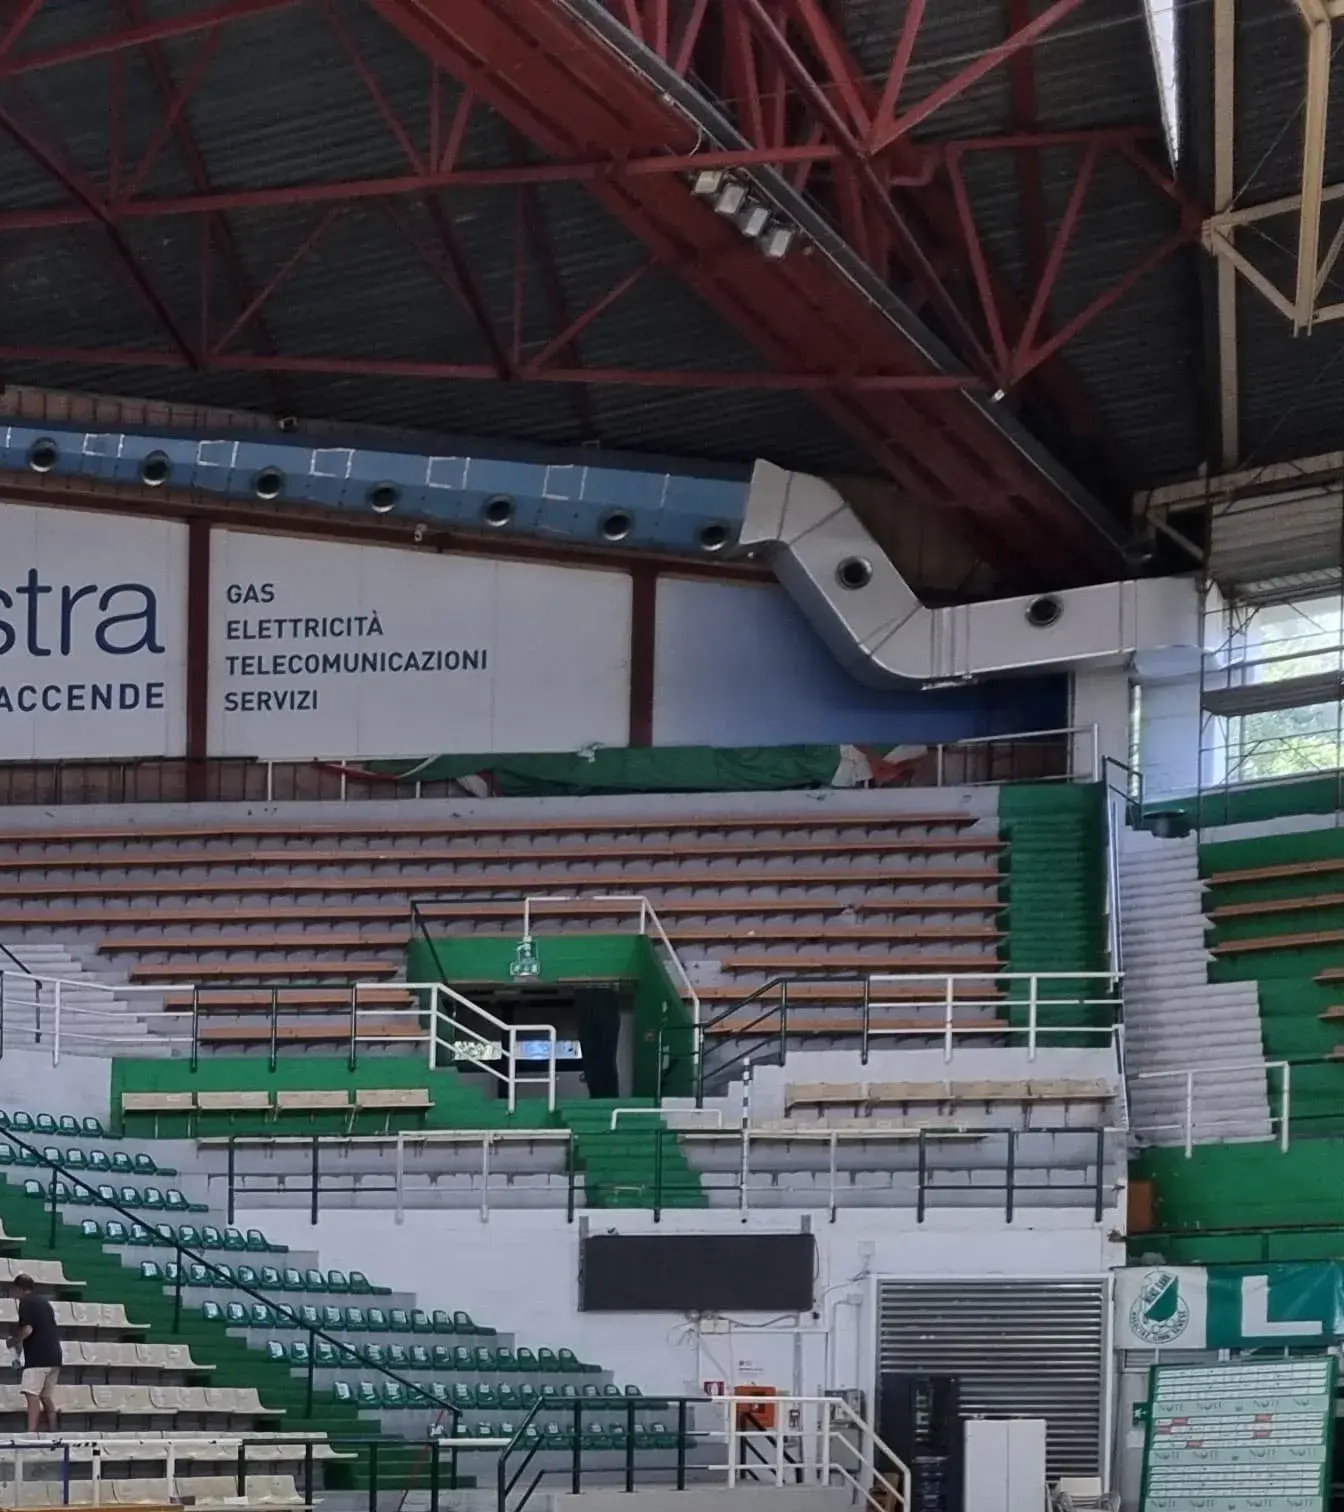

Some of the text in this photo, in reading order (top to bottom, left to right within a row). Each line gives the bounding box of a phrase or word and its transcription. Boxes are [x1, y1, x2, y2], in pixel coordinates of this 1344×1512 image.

[226, 583, 275, 604] GAS
[226, 609, 384, 640] ELETTRICITÀ
[225, 649, 488, 675] TELECOMUNICAZIONI
[224, 690, 318, 712] SERVIZI
